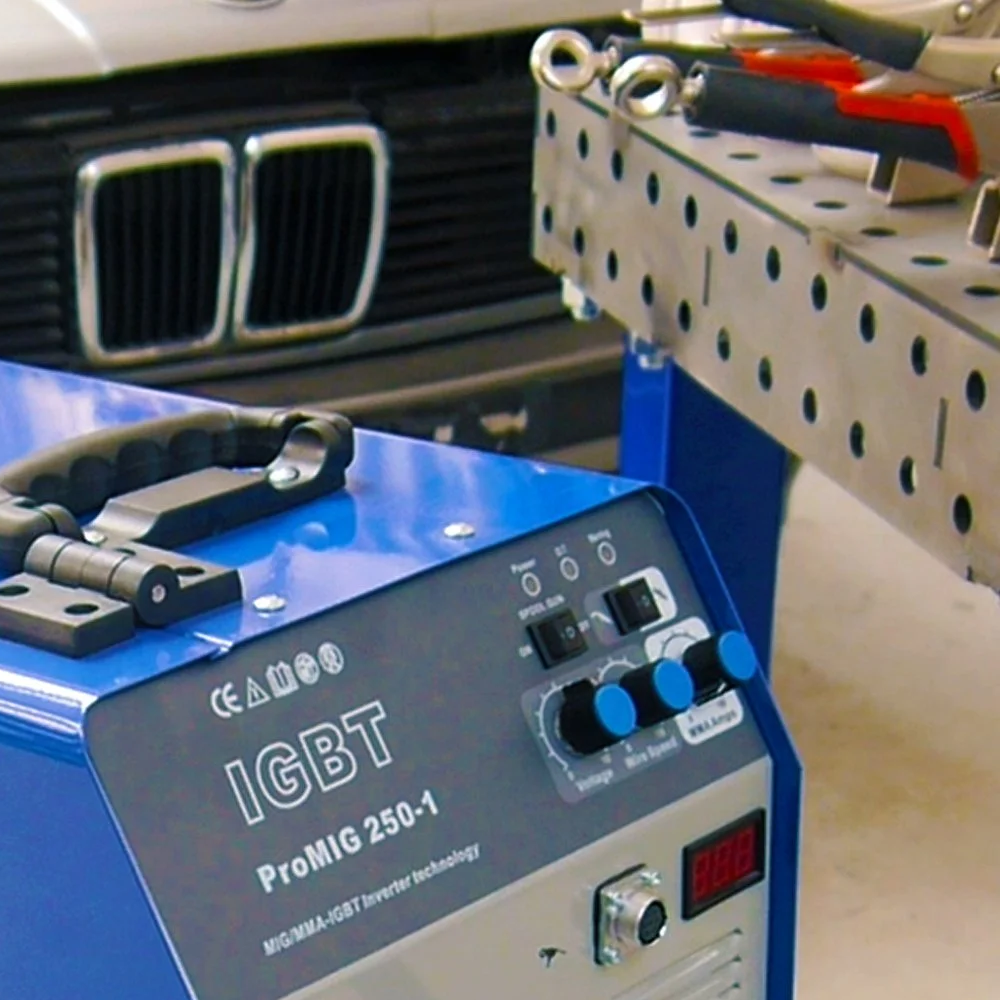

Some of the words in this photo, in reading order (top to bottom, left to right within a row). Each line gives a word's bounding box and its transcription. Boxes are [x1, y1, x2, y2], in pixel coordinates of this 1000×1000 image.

[224, 700, 392, 825] IGBT
[256, 825, 362, 893] ProMIG
[363, 789, 439, 845] 250-1
[263, 896, 362, 956] MIG/MMA-IGBT
[411, 843, 481, 885] technology
